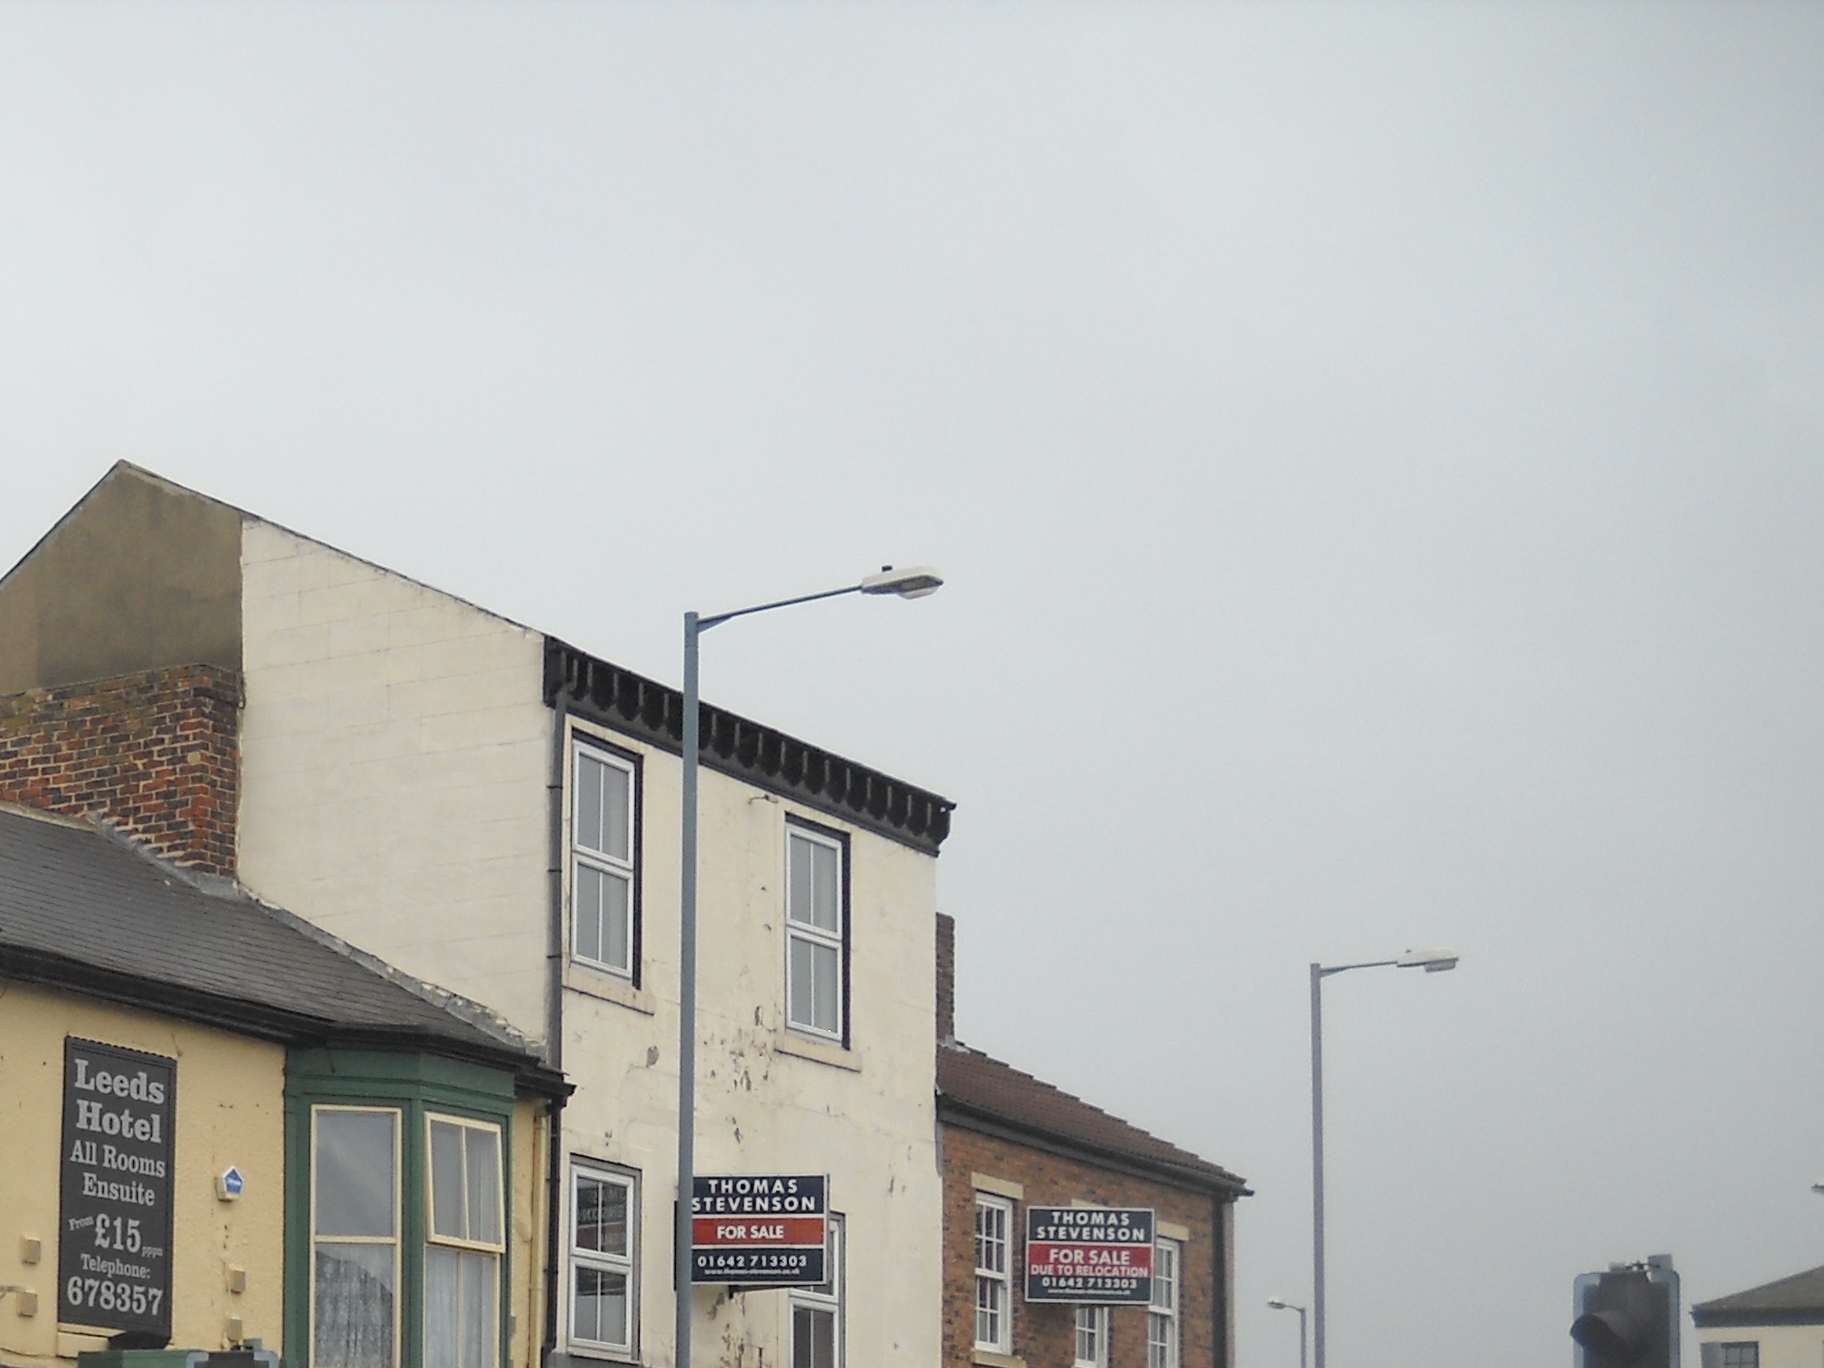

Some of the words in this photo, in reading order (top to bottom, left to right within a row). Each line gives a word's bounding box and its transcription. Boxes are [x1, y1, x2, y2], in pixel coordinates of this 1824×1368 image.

[74, 1058, 165, 1105] Leeds
[76, 1099, 162, 1144] Hotel
[69, 1139, 97, 1166] All
[102, 1143, 165, 1178] Rooms
[82, 1172, 156, 1206] Ensuite
[708, 1179, 798, 1195] THOMAS
[691, 1196, 815, 1212] STEVENSON
[1051, 1211, 1130, 1226] THOMAS
[68, 1215, 94, 1231] From
[95, 1213, 141, 1253] £15
[717, 1225, 746, 1240] FOR
[750, 1225, 784, 1239] SALE
[1037, 1226, 1145, 1241] STEVENSON
[697, 1255, 745, 1267] 01642
[750, 1255, 807, 1267] 713303
[1049, 1249, 1084, 1264] FOR
[1089, 1250, 1130, 1265] SALE
[80, 1253, 151, 1280] Telephone:
[1031, 1264, 1054, 1276] DUE
[1057, 1265, 1074, 1276] TO
[1076, 1265, 1148, 1278] RELOCATION
[1042, 1277, 1083, 1288] 01642
[1087, 1278, 1137, 1289] 713303
[66, 1276, 163, 1316] 678357
